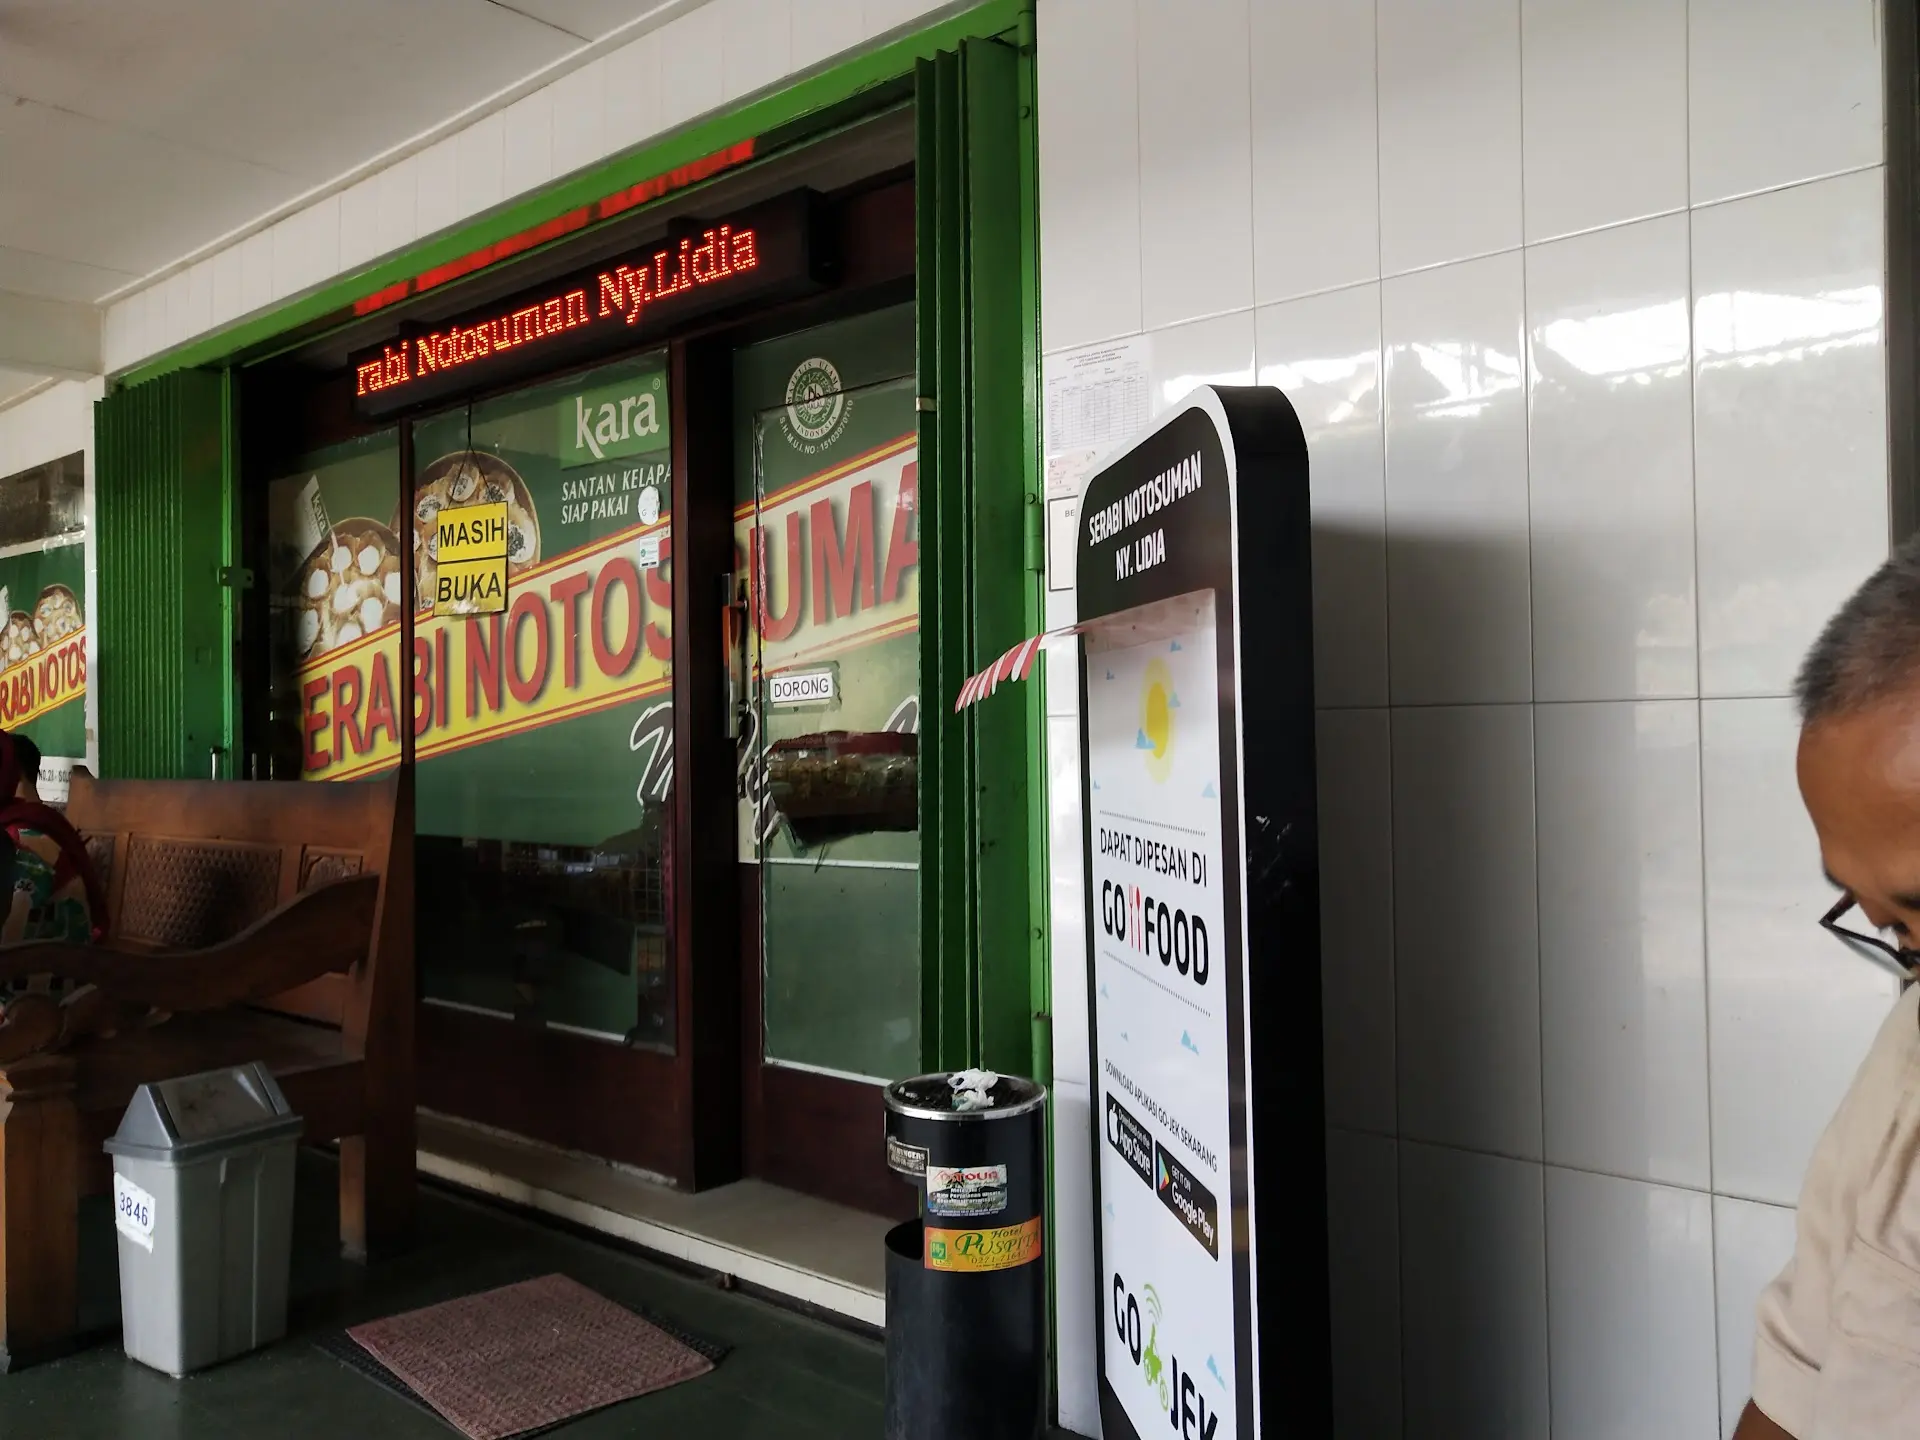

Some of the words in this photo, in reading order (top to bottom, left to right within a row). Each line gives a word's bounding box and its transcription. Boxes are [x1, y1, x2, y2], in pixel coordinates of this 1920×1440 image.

[357, 341, 410, 396] rabi
[416, 290, 589, 377] Notosuman
[598, 225, 757, 324] Ny.Lidia
[575, 393, 660, 458] kara
[796, 416, 836, 438] INDONESIA
[562, 473, 616, 501] SANTAN
[622, 463, 672, 491] KELAPA
[1089, 499, 1123, 547] SERABI
[1124, 450, 1202, 528] NOTOSUMAN
[439, 516, 505, 548] MASIH
[561, 501, 589, 524] SIAP
[590, 495, 629, 520] PAKAI
[1115, 544, 1134, 581] NY.
[1135, 528, 1166, 573] LIDIA
[438, 571, 502, 602] BUKA
[775, 678, 829, 698] DORONG
[1100, 828, 1131, 862] DAPAT
[1136, 837, 1187, 882] DIPESAN
[1192, 851, 1207, 887] DI
[1103, 879, 1126, 942] GO
[1145, 896, 1209, 986] FOOD
[1105, 1058, 1134, 1095] DOWNLOAD
[1134, 1085, 1158, 1122] APLIKASI
[1158, 1107, 1180, 1140] GO-JEK
[1180, 1127, 1218, 1173] SEKARANG
[1119, 1123, 1133, 1160] App
[1132, 1137, 1151, 1176] Store
[1171, 1165, 1180, 1182] GET
[1183, 1177, 1191, 1192] ON
[120, 1192, 149, 1226] 3846
[991, 1227, 1023, 1240] Hotel
[1171, 1181, 1197, 1225] Google
[1198, 1206, 1214, 1246] Play
[1114, 1272, 1141, 1366] GO
